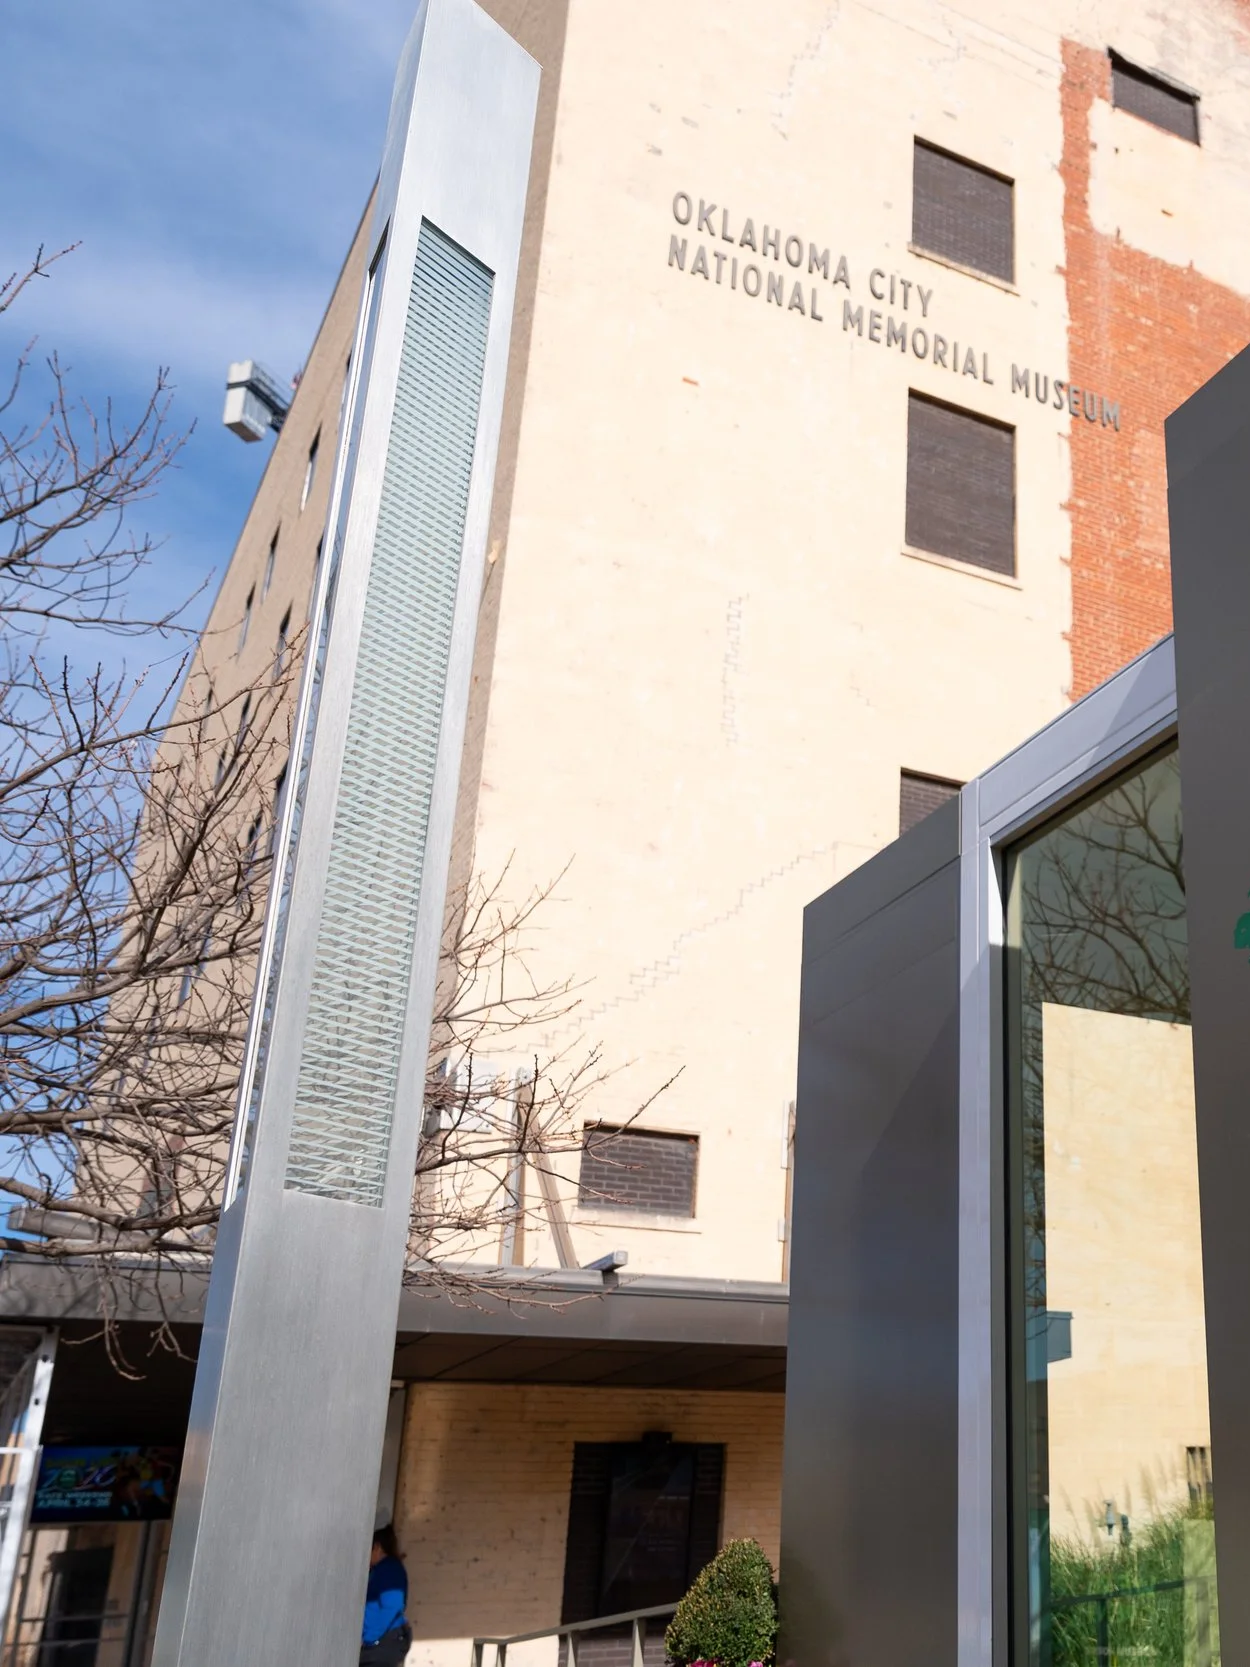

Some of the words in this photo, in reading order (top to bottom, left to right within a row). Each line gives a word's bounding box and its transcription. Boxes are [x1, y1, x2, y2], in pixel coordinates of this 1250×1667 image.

[668, 233, 823, 322] NATIONAL
[842, 300, 994, 386] MEMORIAL
[1011, 362, 1121, 432] MUSEUM
[672, 191, 850, 290] OKLAHOMA
[870, 269, 934, 318] CITY
